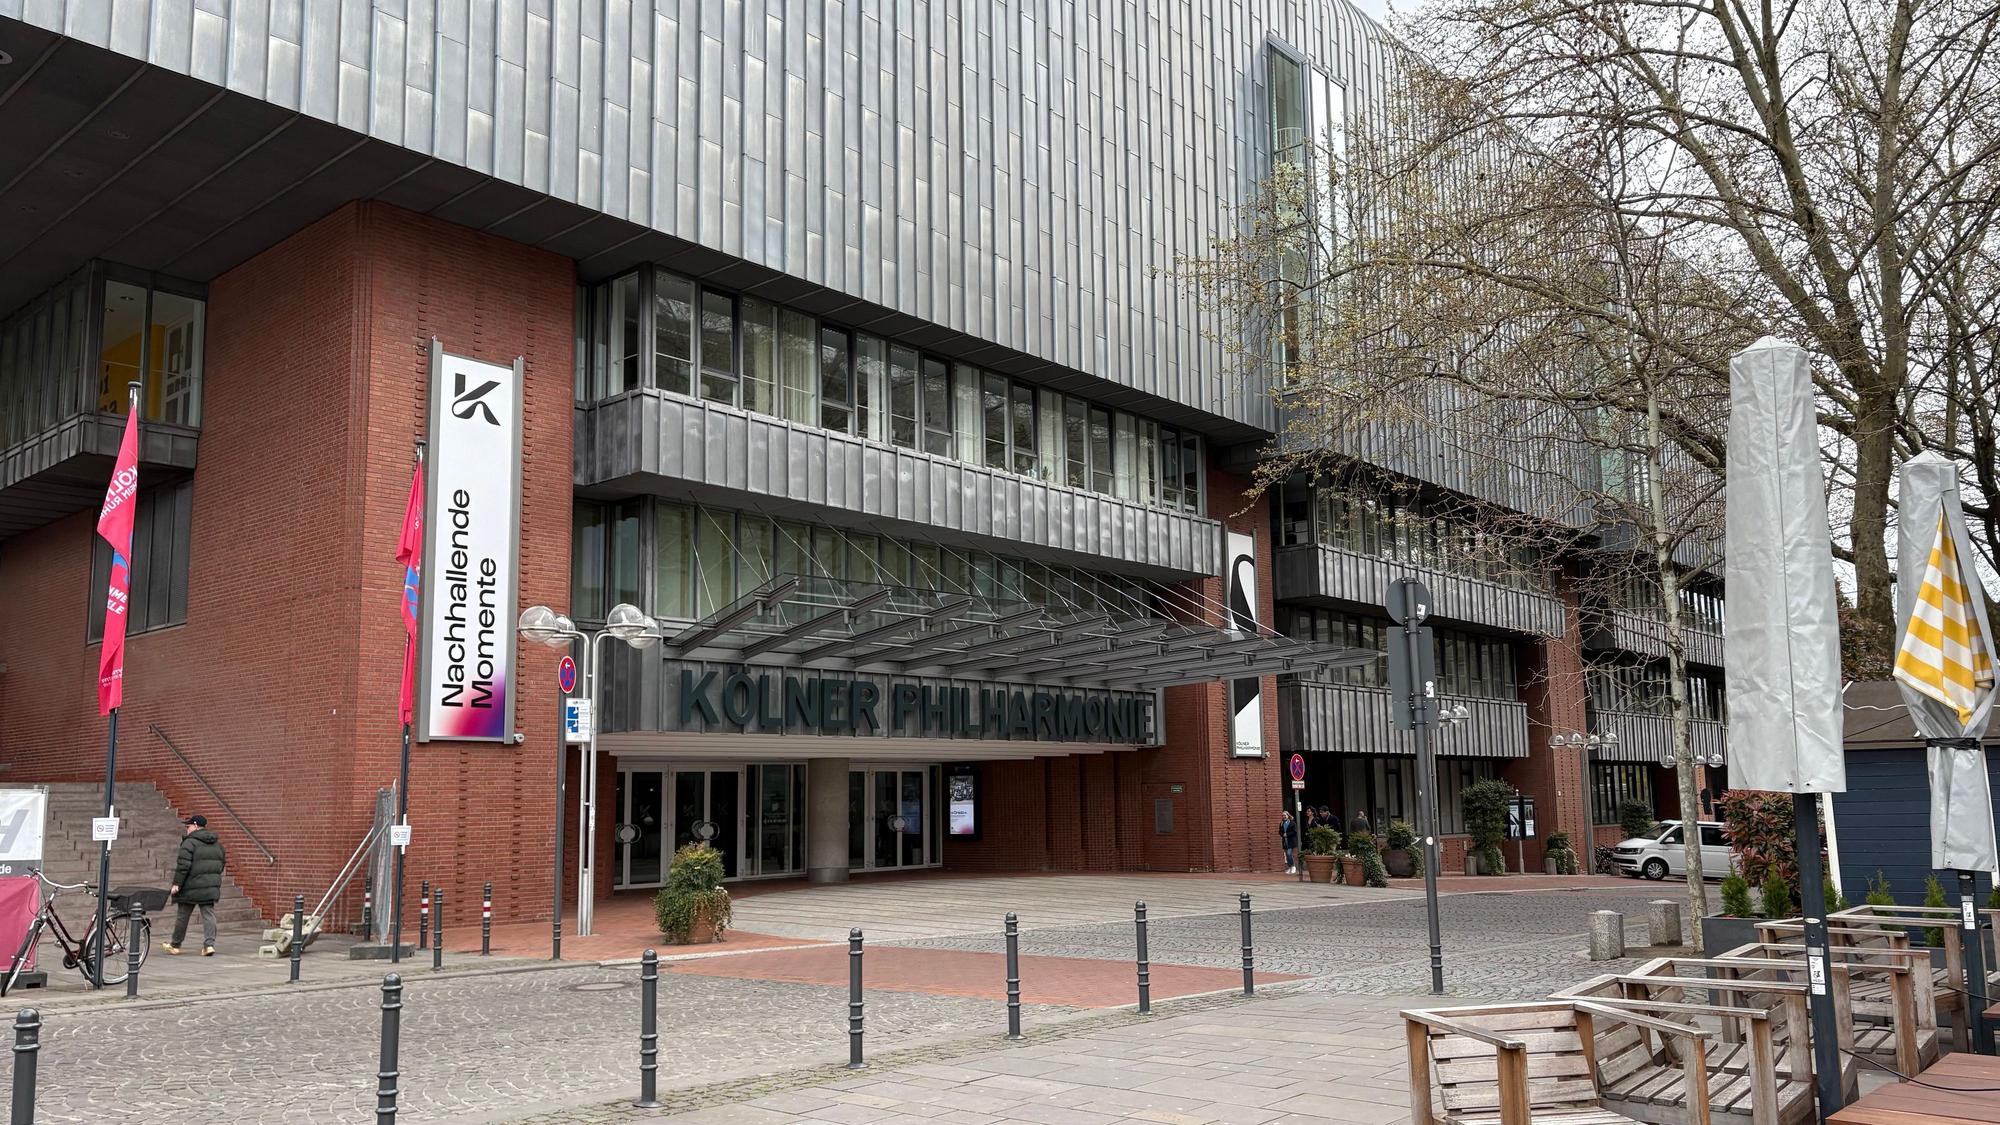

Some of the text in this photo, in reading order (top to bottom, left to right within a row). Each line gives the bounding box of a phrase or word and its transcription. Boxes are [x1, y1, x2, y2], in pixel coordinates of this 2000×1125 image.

[441, 488, 470, 708] Nachhallende
[471, 557, 497, 709] Momente
[681, 664, 1154, 739] KÖLNER PHILHARMONIE
[0, 864, 12, 874] de
